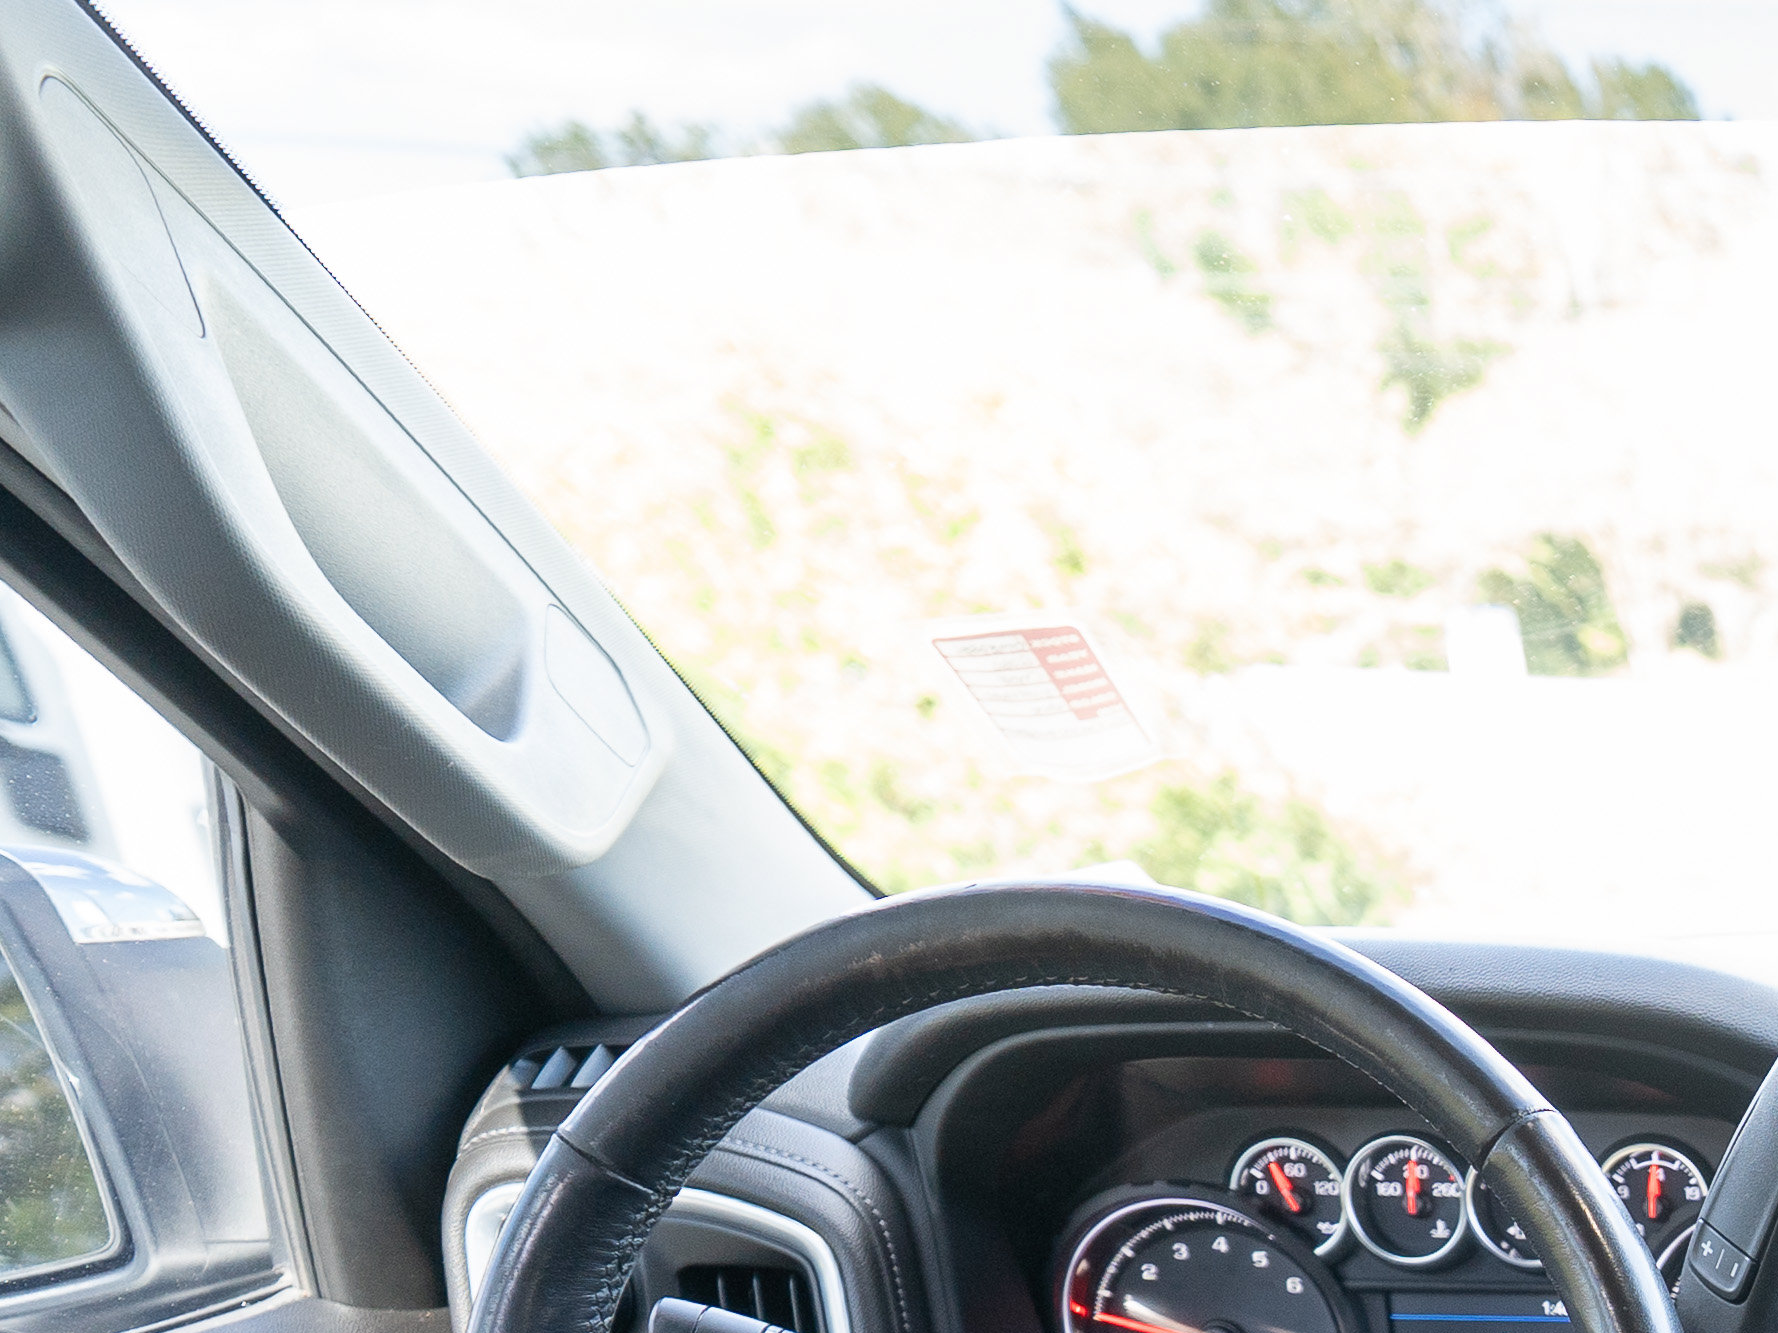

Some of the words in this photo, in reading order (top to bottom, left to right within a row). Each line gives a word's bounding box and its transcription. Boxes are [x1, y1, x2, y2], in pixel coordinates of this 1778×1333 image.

[1284, 1163, 1307, 1178] 60
[1255, 1180, 1269, 1195] 0
[1313, 1181, 1339, 1196] 120
[1172, 1242, 1190, 1261] 3
[1212, 1236, 1229, 1254] 4
[1251, 1250, 1269, 1268] 5
[1140, 1263, 1158, 1281] 2
[1285, 1276, 1304, 1294] 6
